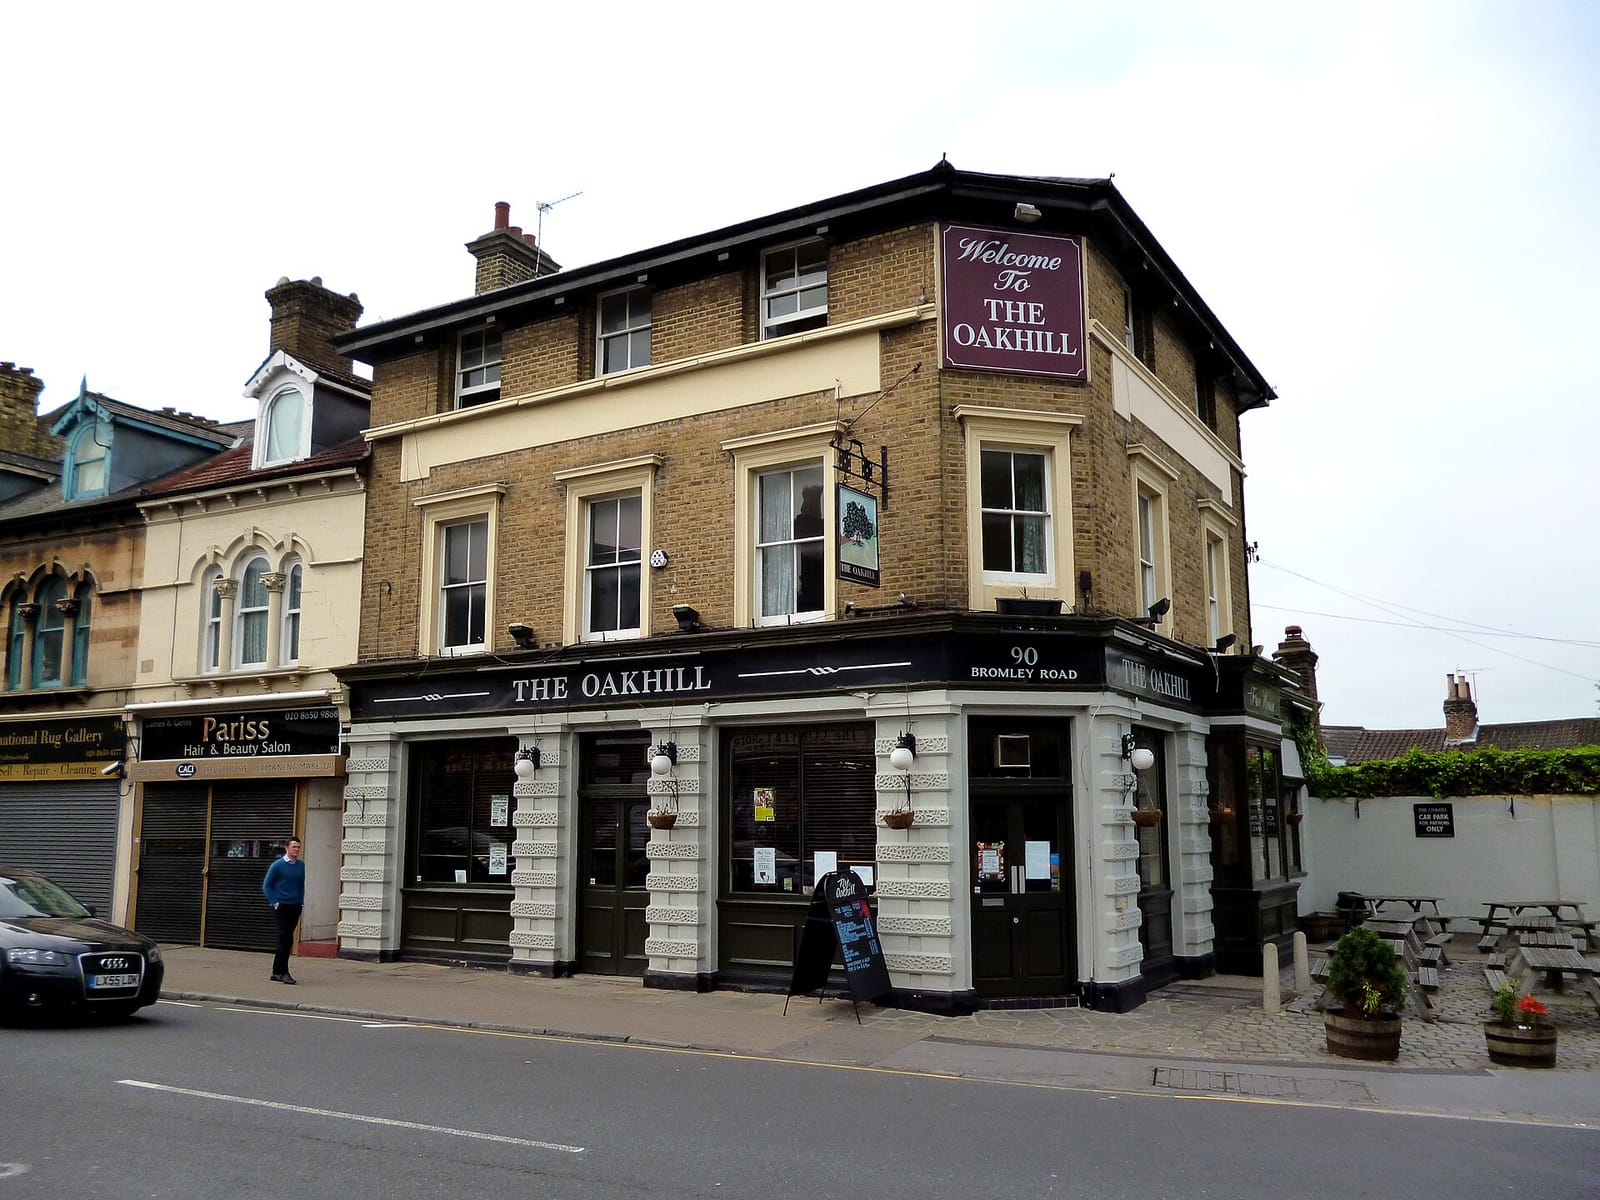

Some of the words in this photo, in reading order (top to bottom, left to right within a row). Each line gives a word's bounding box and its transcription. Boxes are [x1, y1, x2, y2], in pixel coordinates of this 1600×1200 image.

[957, 238, 1061, 270] Welcome
[994, 270, 1031, 292] To
[984, 298, 1046, 326] THE
[953, 323, 1077, 356] OAKHILL
[841, 563, 852, 573] THE
[853, 567, 875, 579] OAKHILL
[1010, 646, 1039, 666] 90
[971, 667, 1034, 679] BROMLEY
[1040, 669, 1078, 680] ROAD
[1122, 658, 1147, 689] THE
[1150, 668, 1192, 701] OAKHILL
[512, 676, 569, 702] THE
[581, 666, 712, 698] OAKHILL
[285, 712, 299, 721] 020
[300, 711, 319, 720] 8650
[40, 730, 62, 748] Rug
[64, 728, 104, 747] Gallery
[203, 715, 270, 742] Pariss
[184, 744, 205, 756] Hair
[210, 743, 219, 755] &
[223, 743, 259, 757] Beauty
[262, 741, 291, 753] Salon
[330, 745, 338, 753] 92
[23, 765, 50, 779] Repair
[60, 763, 98, 777] Cleaning
